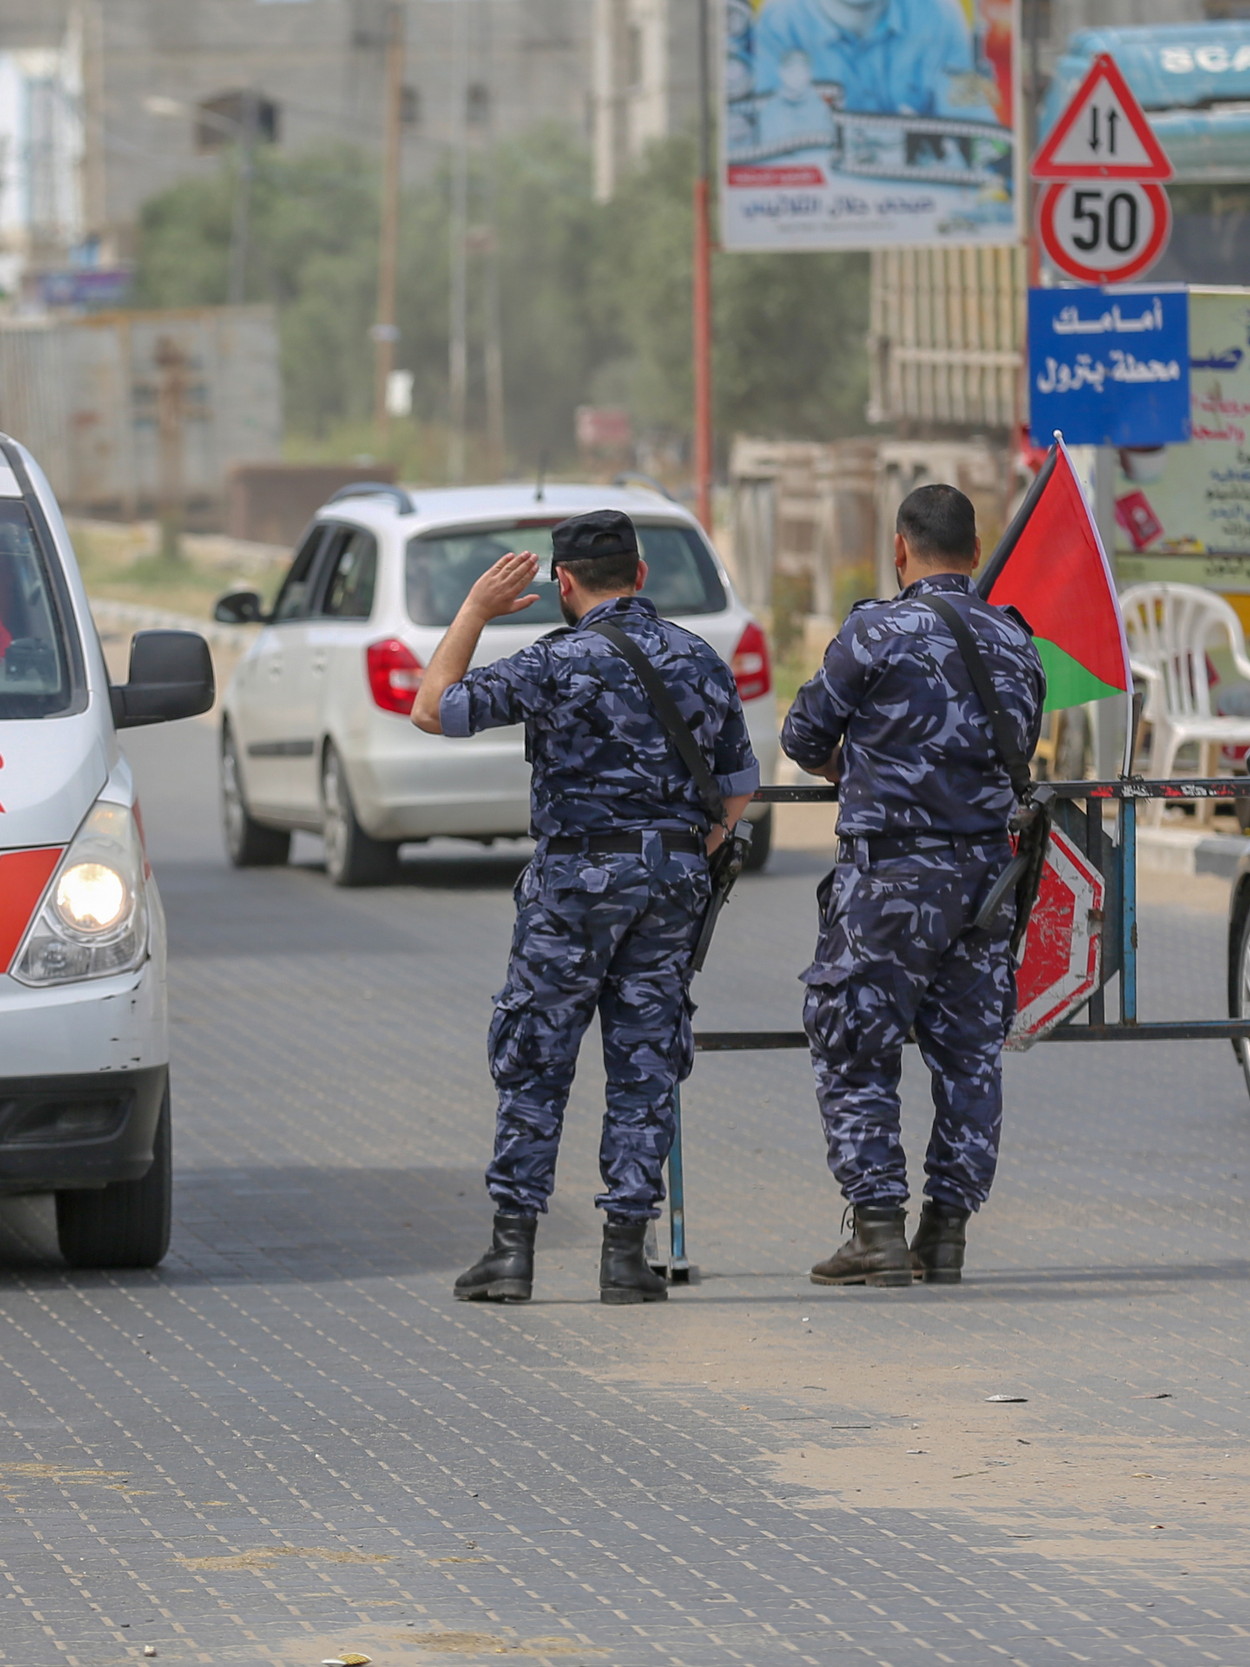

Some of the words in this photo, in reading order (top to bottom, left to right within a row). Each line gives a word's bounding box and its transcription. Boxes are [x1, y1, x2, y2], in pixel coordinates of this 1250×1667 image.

[1071, 189, 1139, 253] 50
[1036, 354, 1105, 394] بترول
[1109, 350, 1180, 383] محطة
